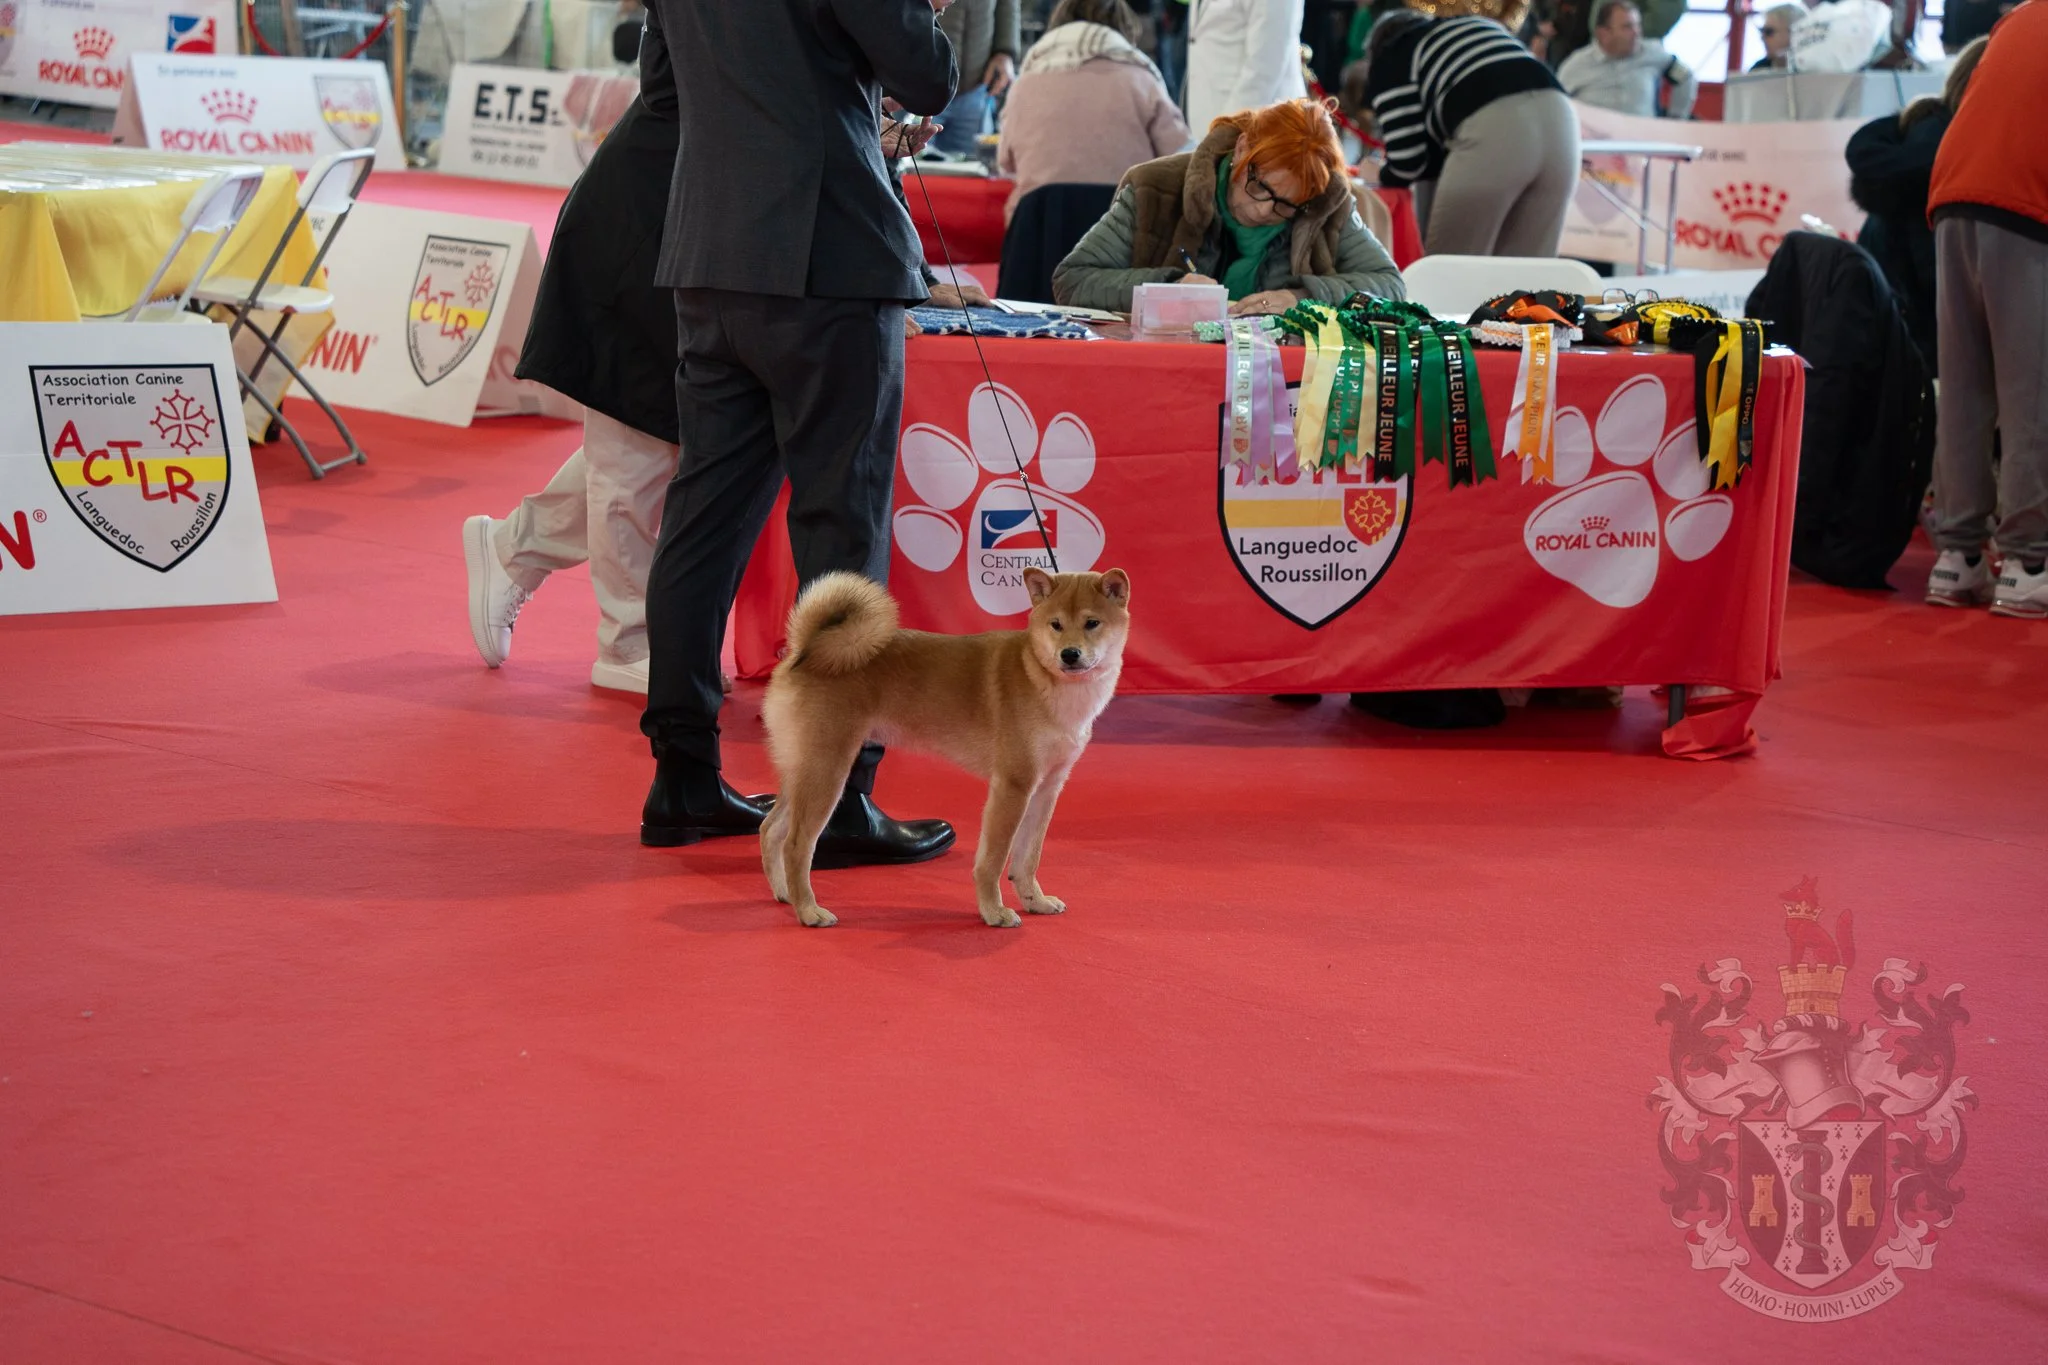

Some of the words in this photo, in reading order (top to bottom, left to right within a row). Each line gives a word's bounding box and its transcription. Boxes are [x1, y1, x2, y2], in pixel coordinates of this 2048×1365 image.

[39, 59, 90, 89] ROYAL
[161, 129, 236, 154] ROYAL
[240, 130, 314, 155] CANIN
[1675, 219, 1754, 258] ROYAL
[1236, 322, 1250, 391] MILLEUR
[43, 373, 129, 387] Association
[135, 372, 184, 385] Canine
[45, 391, 137, 407] Territoriale
[1378, 411, 1395, 463] JEUNE
[1453, 416, 1469, 468] JEUNE
[52, 420, 200, 504] ACTLR
[76, 490, 145, 555] Languedoc
[170, 491, 216, 552] Roussillon
[1239, 534, 1358, 559] Languedoc
[1536, 533, 1591, 551] ROYAL
[1596, 531, 1656, 549] CANIN
[1261, 563, 1367, 583] Roussillon
